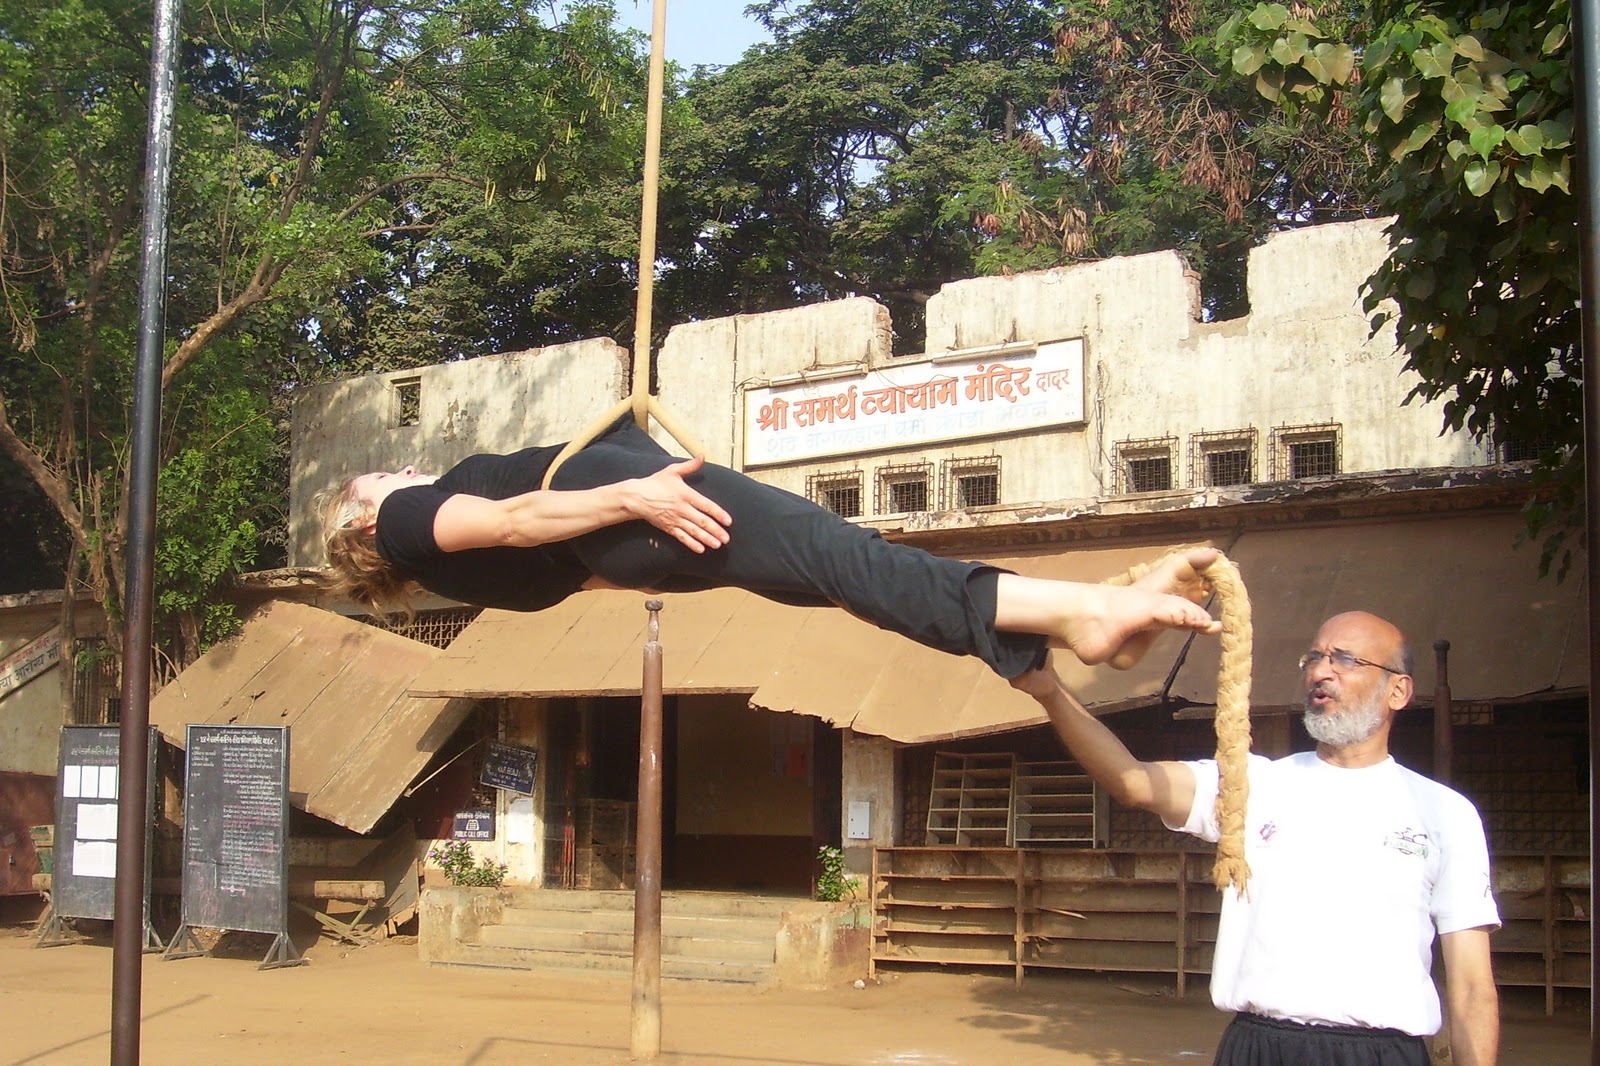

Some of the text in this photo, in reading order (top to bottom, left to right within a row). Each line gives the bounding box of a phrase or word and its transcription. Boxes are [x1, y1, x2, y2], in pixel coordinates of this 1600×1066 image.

[756, 363, 1070, 431] श्री समर्थ व्यायाम मंदिर दादर
